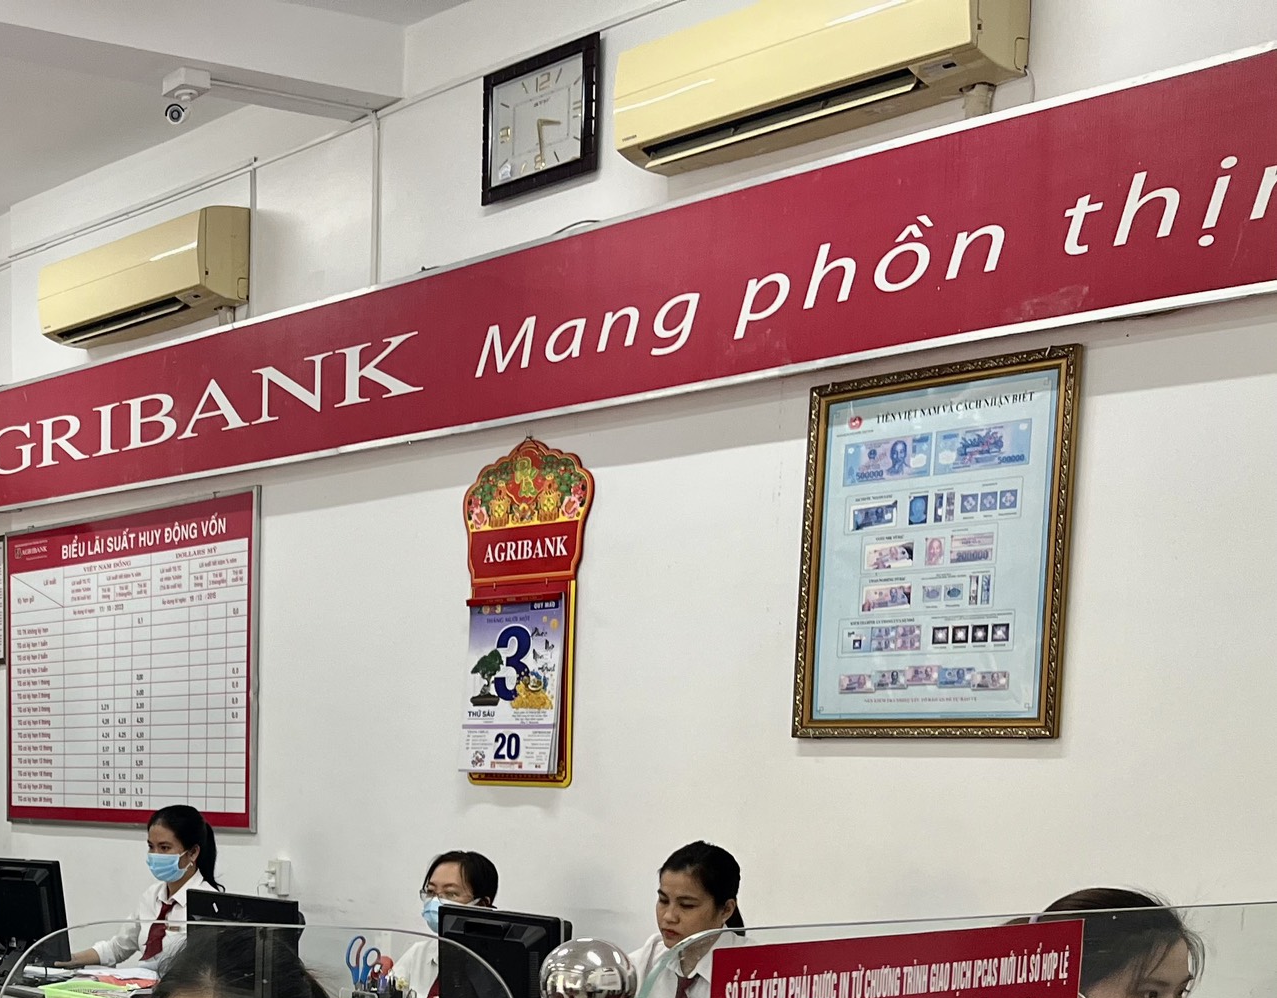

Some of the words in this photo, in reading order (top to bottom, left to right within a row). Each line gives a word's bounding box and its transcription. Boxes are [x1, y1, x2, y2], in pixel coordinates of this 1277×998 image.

[535, 72, 551, 92] 12
[475, 291, 699, 378] Mang
[734, 215, 1005, 338] phồn
[920, 405, 940, 417] NAM
[997, 454, 1025, 464] 500000
[61, 535, 85, 559] BIỂU
[87, 535, 104, 555] LÃI
[106, 528, 136, 552] SUẤT
[138, 528, 161, 547] HUY
[164, 521, 197, 544] ĐỘNG
[201, 512, 226, 536] VỐN
[175, 549, 206, 560] DOLLARS
[483, 536, 567, 563] AGRIBANK
[494, 625, 531, 701] 3
[483, 710, 495, 718] SÁU
[493, 732, 521, 760] 20
[864, 965, 901, 998] CHƯƠNG
[902, 959, 928, 995] TRÌNH
[929, 962, 950, 993] GIAO
[950, 960, 972, 996] DỊCH
[972, 957, 998, 988] IPCAS
[998, 950, 1016, 985] MỚI
[1016, 949, 1027, 983] LÀ
[1028, 942, 1041, 982] SỔ
[1040, 951, 1058, 986] HỢP
[1058, 944, 1069, 985] LỆ
